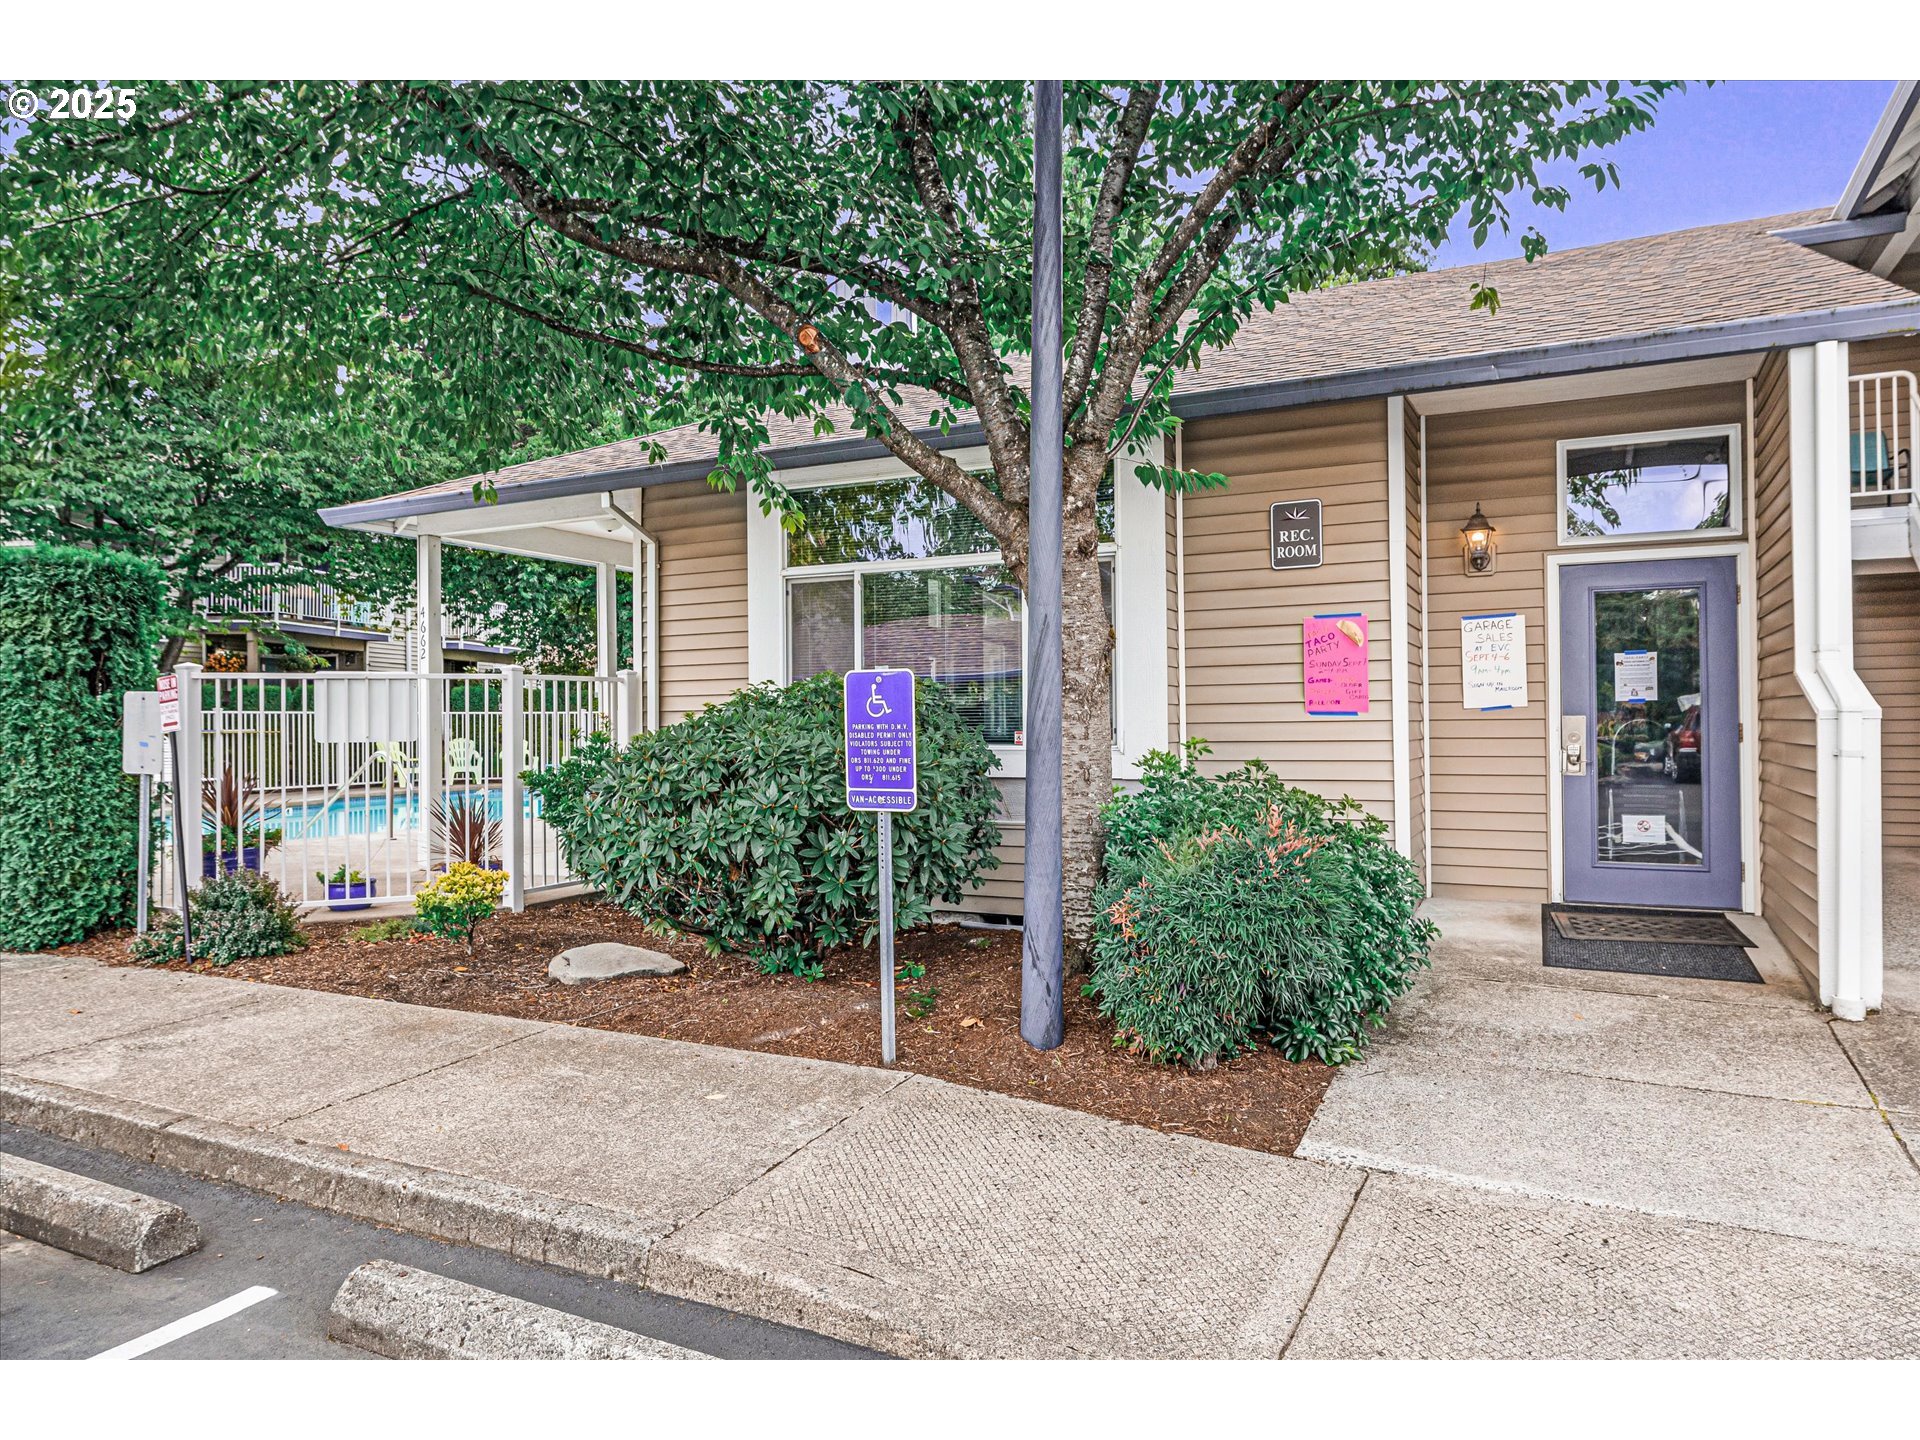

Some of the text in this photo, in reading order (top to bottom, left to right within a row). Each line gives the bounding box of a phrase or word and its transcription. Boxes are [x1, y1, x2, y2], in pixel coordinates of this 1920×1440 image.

[1279, 528, 1314, 543] REC.
[1276, 543, 1318, 559] ROOM
[1463, 618, 1513, 633] GARAGE
[1305, 632, 1336, 649] TACO
[1475, 632, 1513, 644] SALES
[1307, 640, 1340, 658] PARTY
[1490, 643, 1510, 652] EVC
[1308, 658, 1342, 669] SUNDAY
[1465, 650, 1489, 663] SEPT
